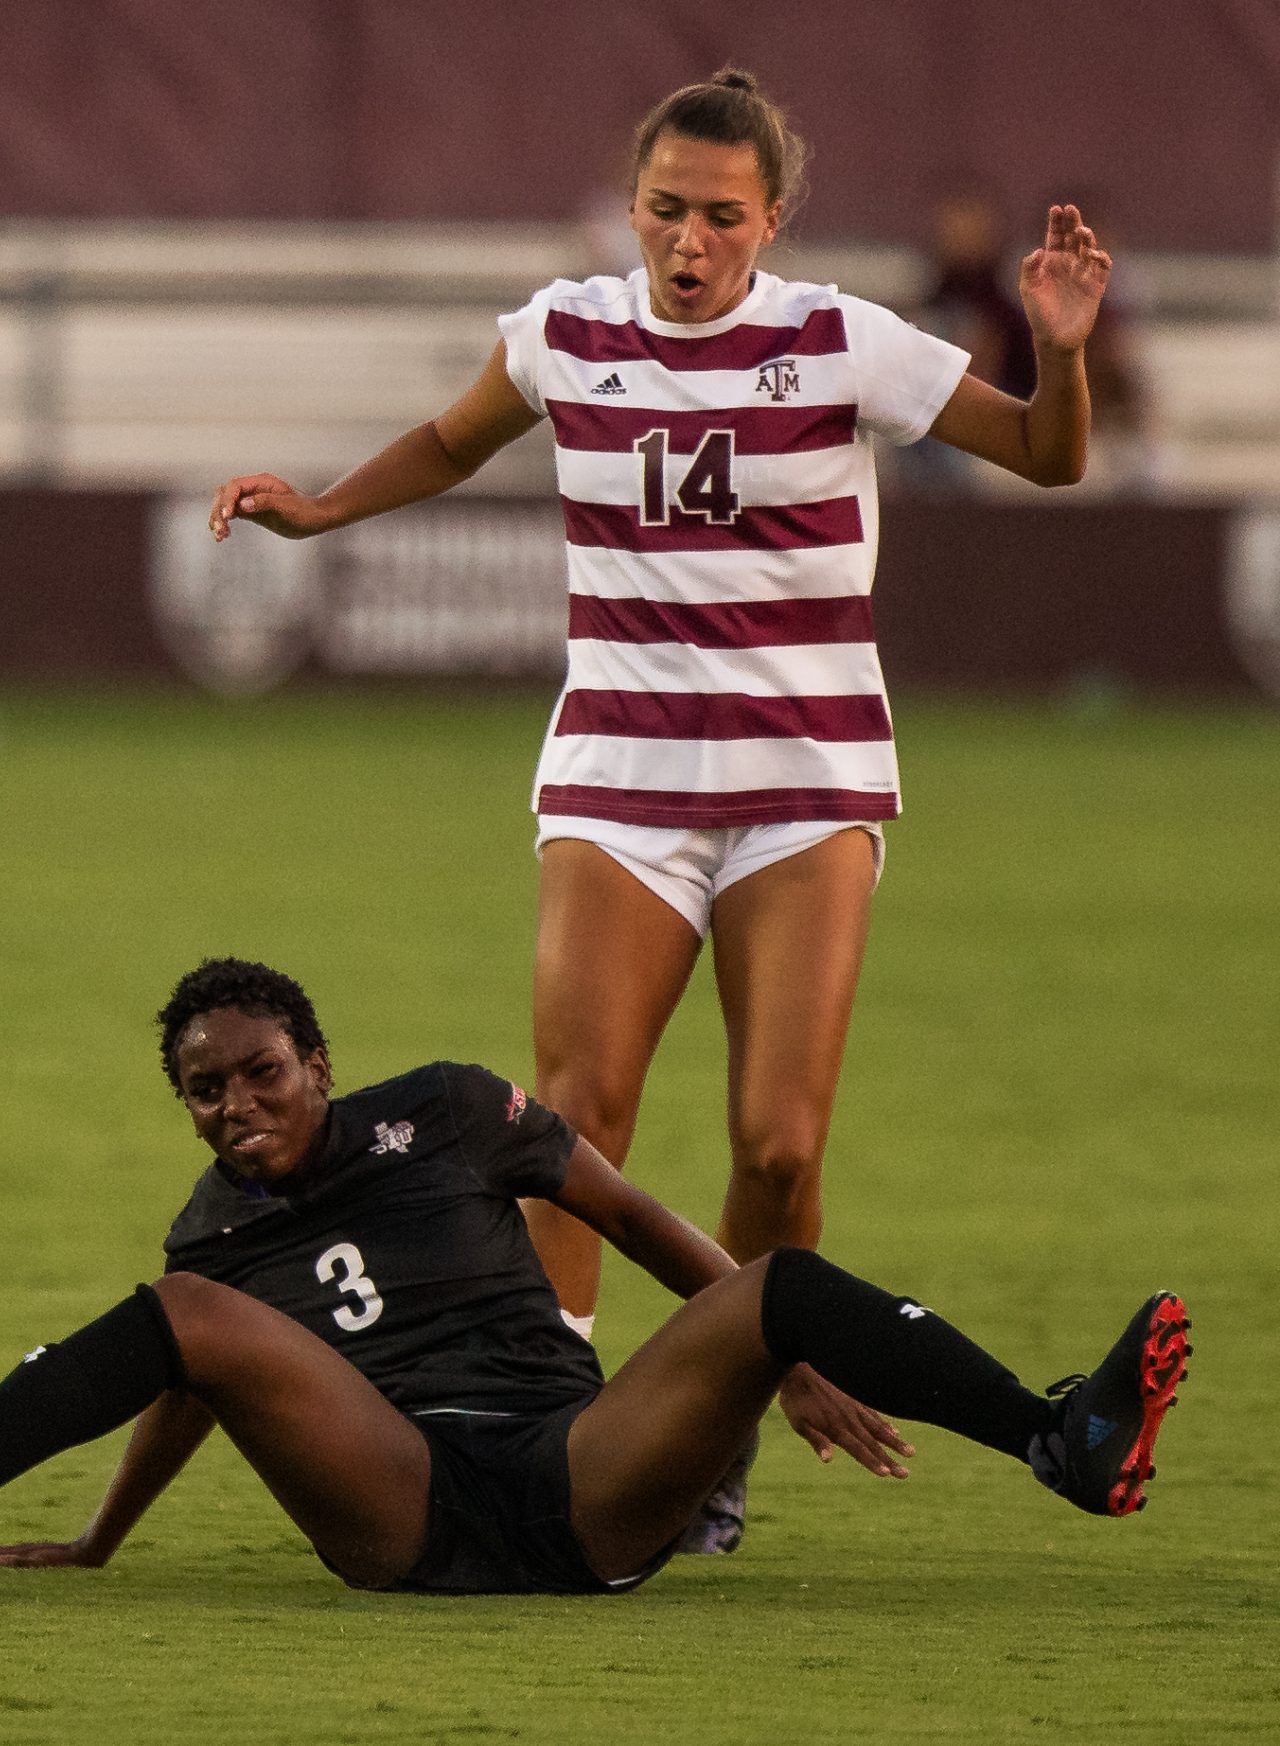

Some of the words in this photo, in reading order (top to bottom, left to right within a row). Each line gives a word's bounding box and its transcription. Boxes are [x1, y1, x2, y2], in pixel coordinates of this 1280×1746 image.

[590, 387, 627, 395] adidas
[634, 428, 742, 527] 14
[315, 1242, 384, 1333] 3
